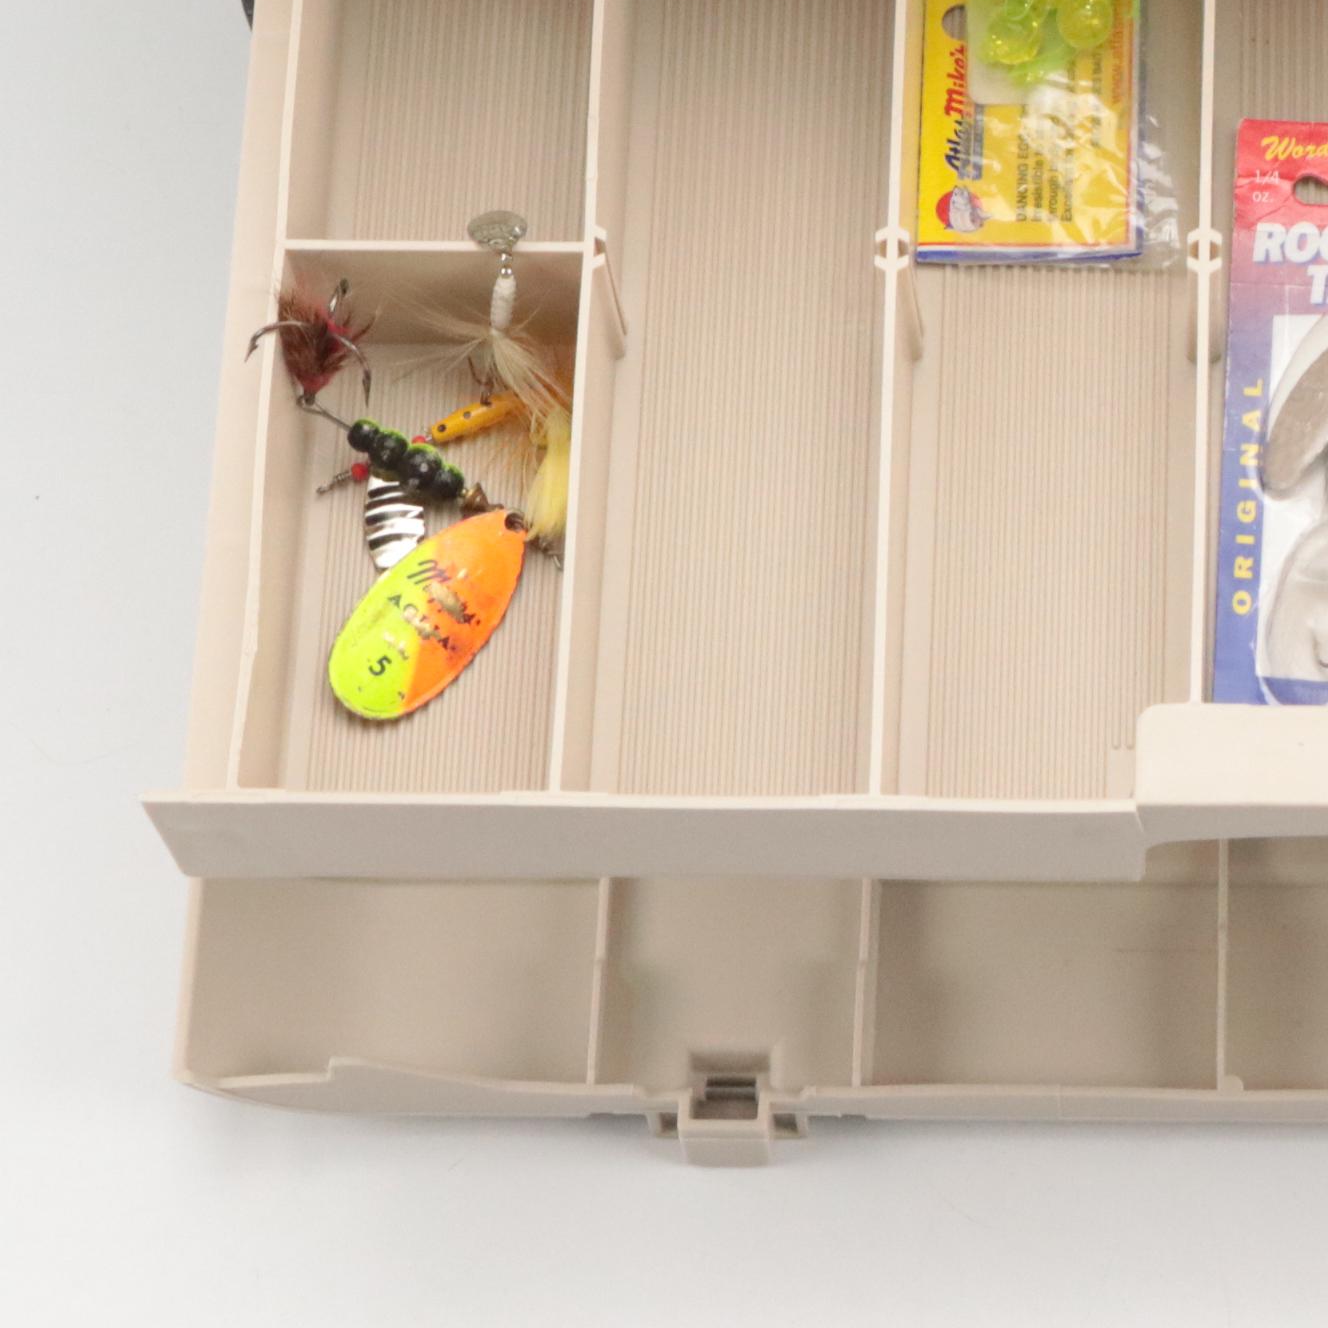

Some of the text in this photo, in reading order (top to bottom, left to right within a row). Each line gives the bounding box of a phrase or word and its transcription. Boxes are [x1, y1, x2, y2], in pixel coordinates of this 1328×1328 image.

[944, 45, 969, 116] Mike's
[944, 118, 966, 171] Atlas
[1016, 163, 1029, 222] DANCING
[1252, 191, 1274, 203] oz.
[1254, 169, 1280, 185] 1/4
[1232, 377, 1265, 615] ORIGINAL
[367, 655, 393, 677] 5
